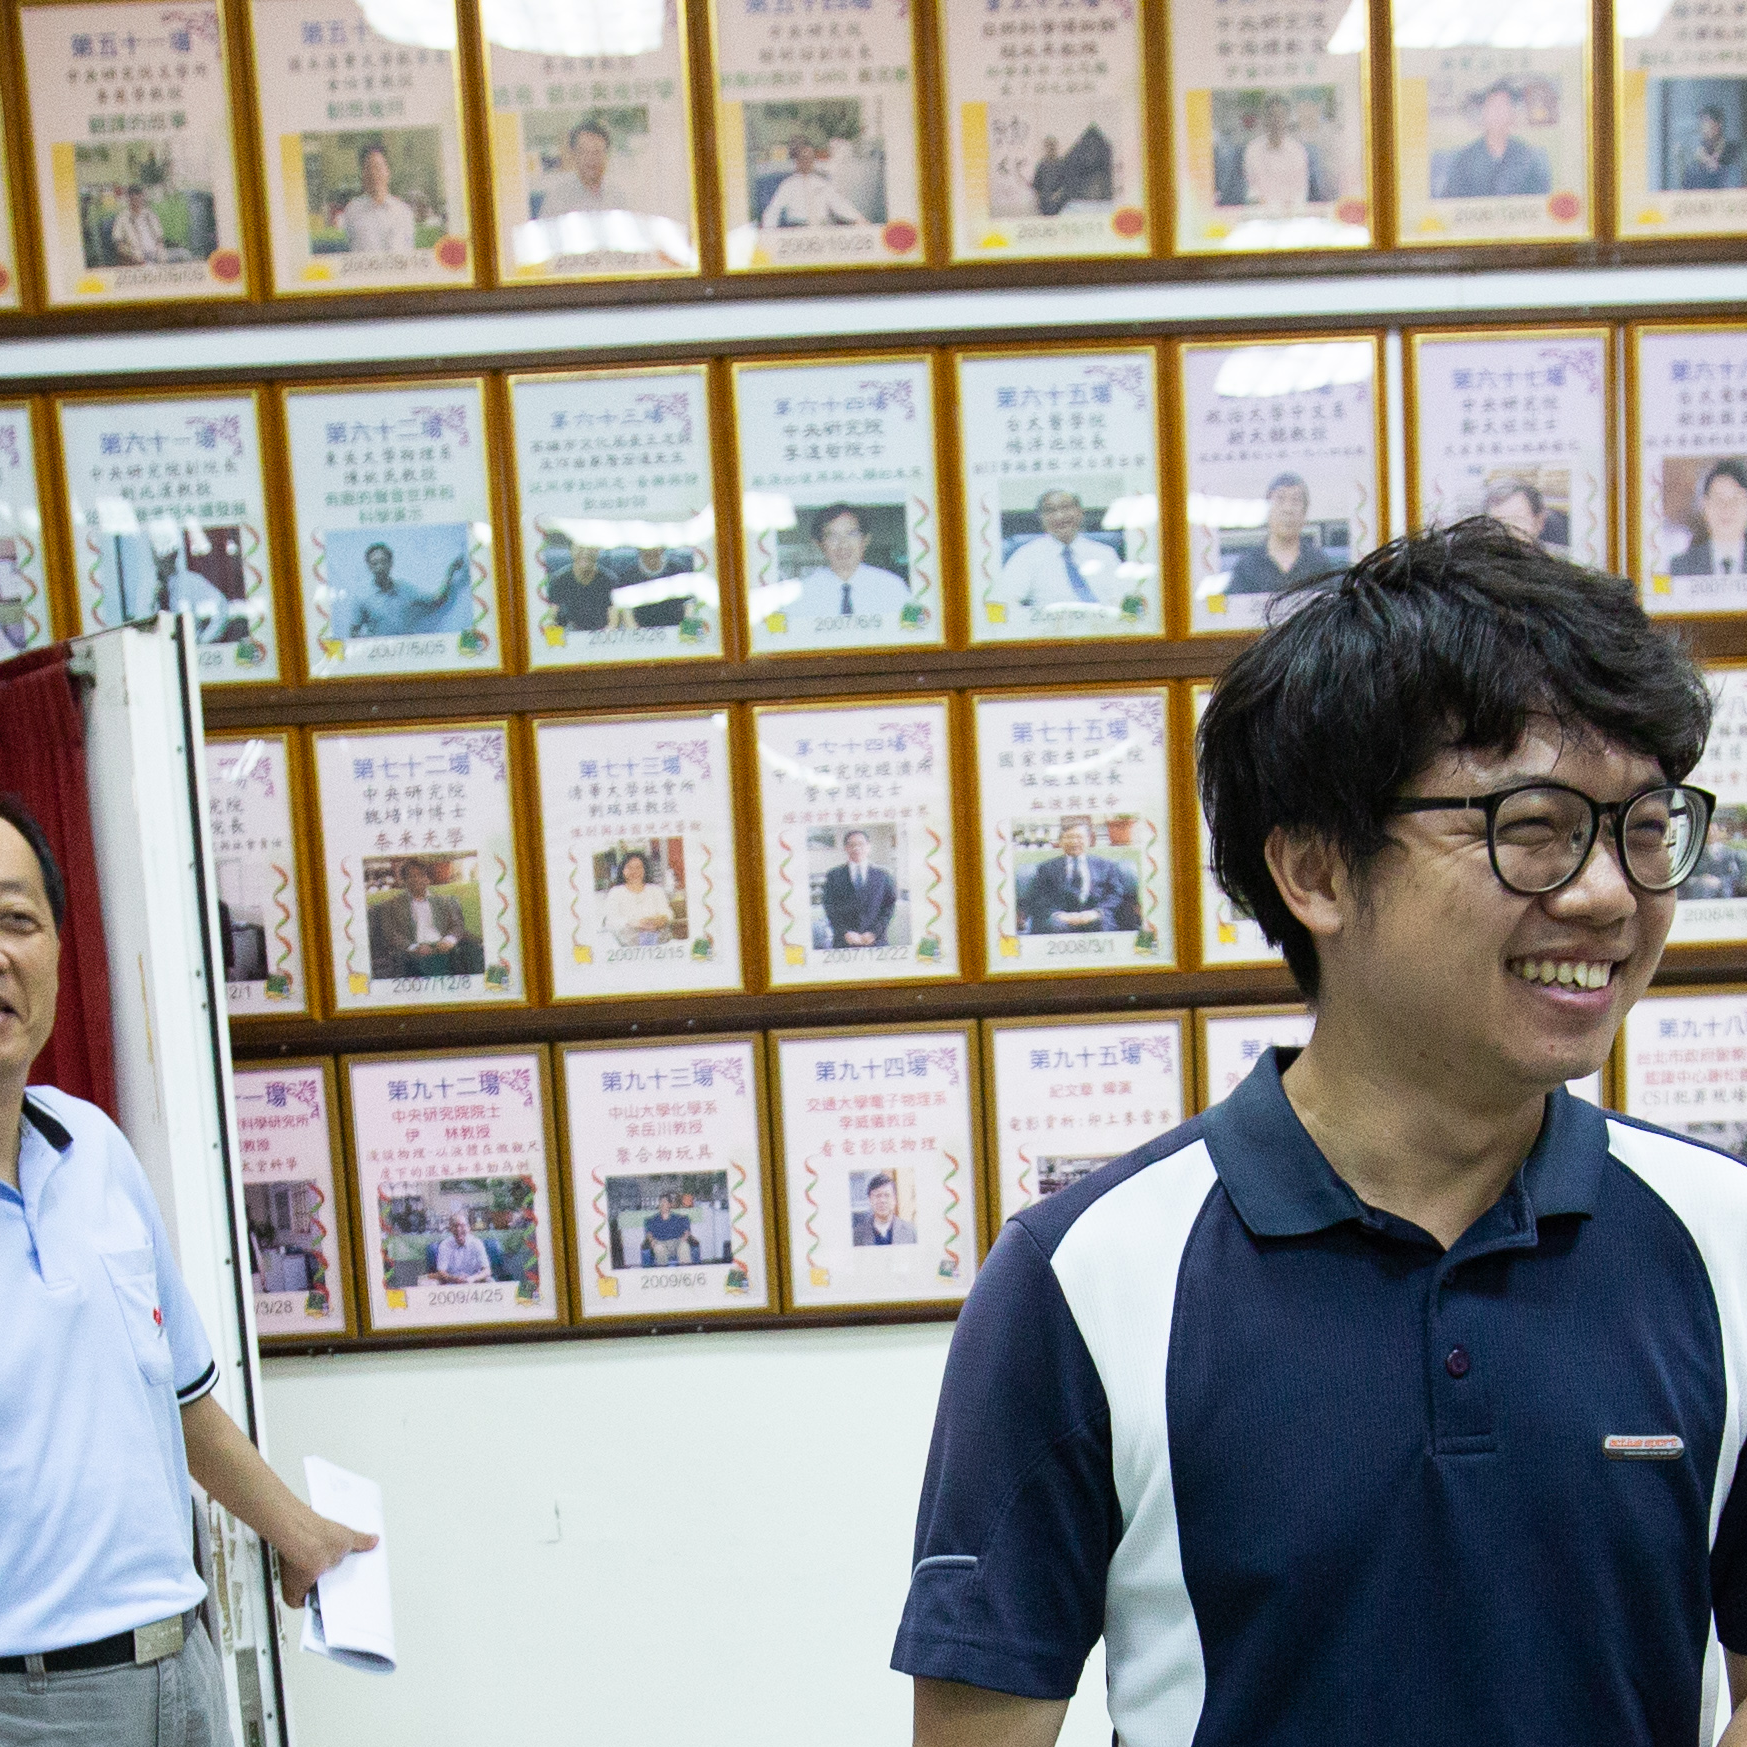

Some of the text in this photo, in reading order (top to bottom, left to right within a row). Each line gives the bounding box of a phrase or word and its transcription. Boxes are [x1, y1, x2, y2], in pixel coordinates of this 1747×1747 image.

[774, 393, 888, 416] 第六十四場
[996, 381, 1112, 409] 第六十五場
[325, 414, 443, 445] 第六十二場
[551, 404, 665, 430] 第六十三場
[100, 425, 217, 457] 第六十一場
[1011, 717, 1129, 744] 第七十五場
[795, 734, 908, 757] 第七十四場
[998, 746, 1145, 769] 國家衛生研院
[352, 752, 471, 781] 第七十二場
[578, 755, 682, 780] 第七十三場
[363, 782, 467, 802] 中央研究院
[606, 945, 686, 963] 2007/12/15
[1029, 1042, 1141, 1070] 第九十五場
[600, 1067, 715, 1094] 第九十三場
[815, 1057, 928, 1083] 第九十四場
[387, 1070, 501, 1102] 第九十二場
[392, 1104, 502, 1125] 中央研究院院士
[608, 1099, 719, 1121] 中山大學化學系
[806, 1091, 948, 1114] 交通大學電子物理系
[640, 1272, 708, 1291] 2009/6/6
[428, 1288, 504, 1307] 2009/4/25
